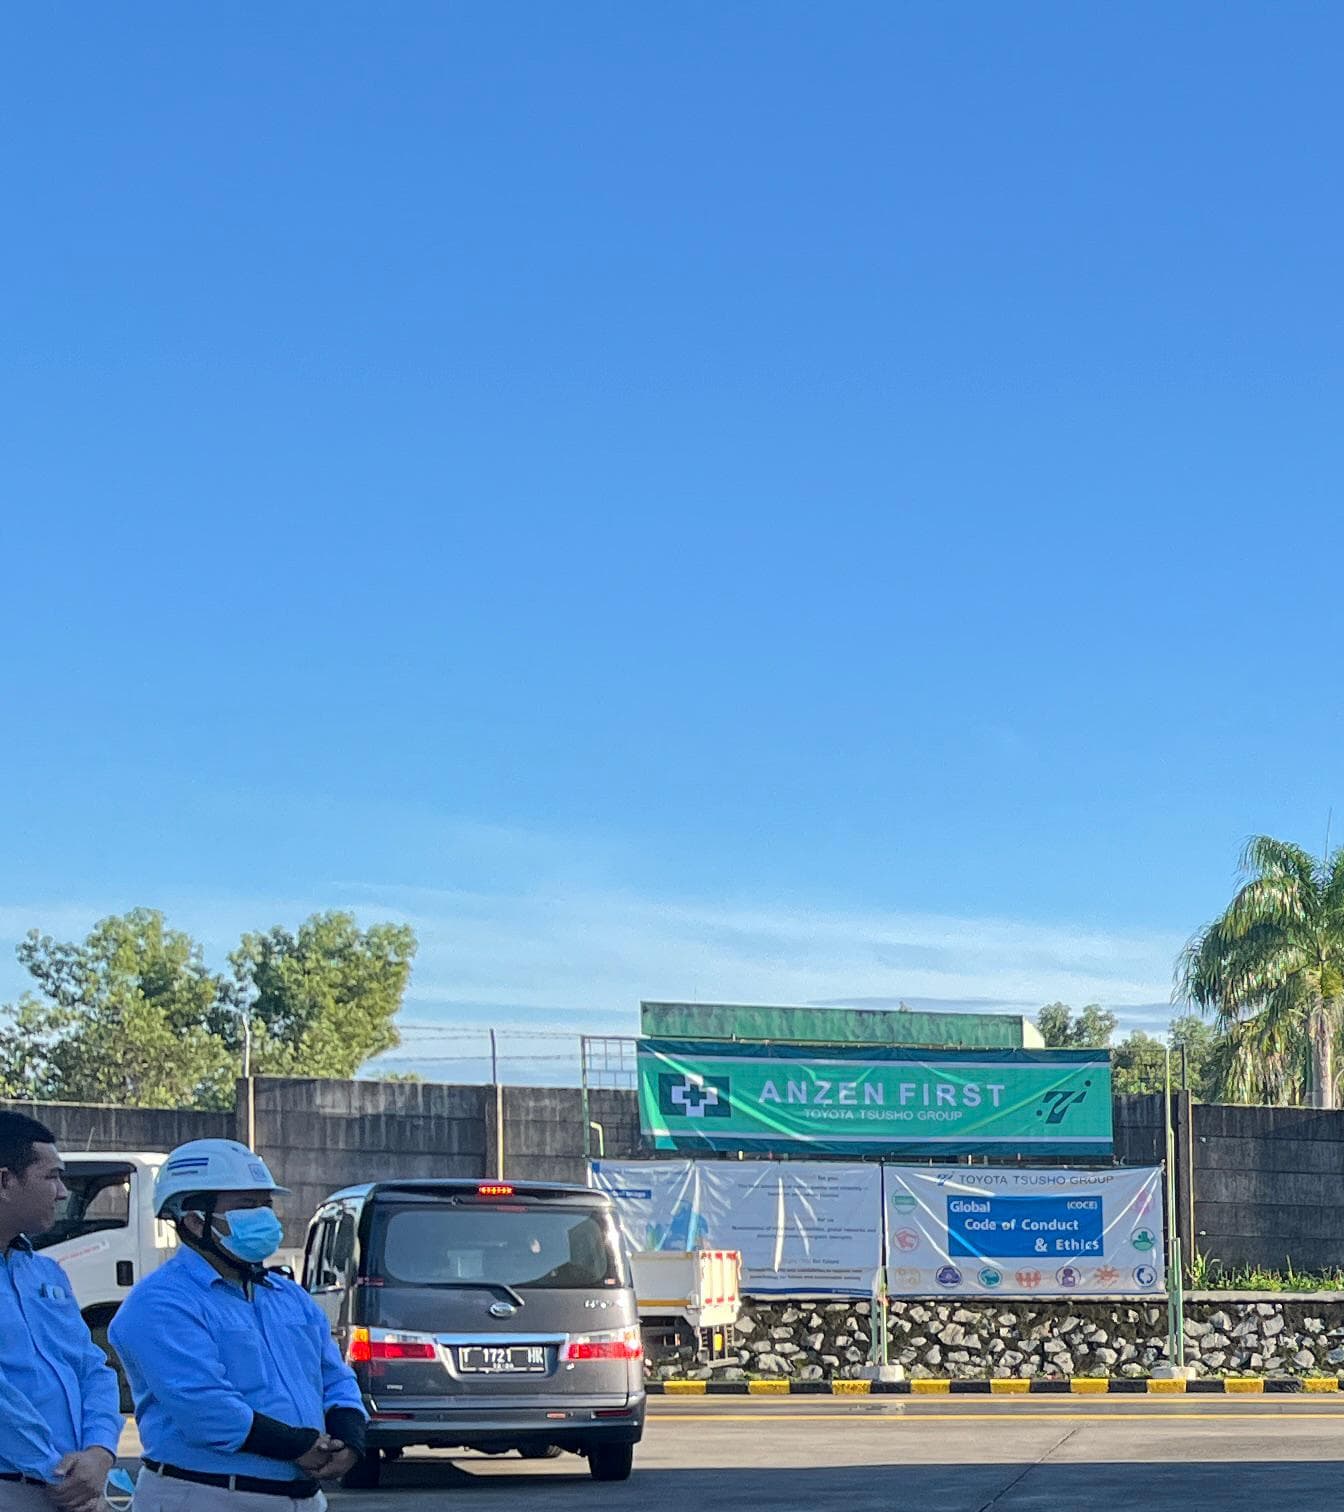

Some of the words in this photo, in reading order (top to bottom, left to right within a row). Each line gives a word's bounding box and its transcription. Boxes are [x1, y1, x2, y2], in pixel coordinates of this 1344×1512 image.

[758, 1080, 884, 1105] ANZEN
[899, 1082, 1006, 1107] FIRST
[804, 1108, 854, 1119] TOYOTA
[860, 1109, 914, 1120] TSUSHO
[917, 1110, 963, 1121] GROUP
[959, 1175, 1008, 1185] TOYOTA
[1013, 1175, 1066, 1185] TSUSHO
[1069, 1175, 1115, 1185] GROUP
[950, 1201, 991, 1213] Global
[1067, 1200, 1098, 1210] (COCE)
[964, 1218, 997, 1230] Code
[1001, 1218, 1016, 1230] of
[1021, 1219, 1079, 1231] Conduct
[1034, 1237, 1048, 1252] &
[1056, 1239, 1100, 1251] Ethics
[462, 1349, 470, 1362] T
[482, 1348, 512, 1363] 1721
[528, 1347, 544, 1363] HK
